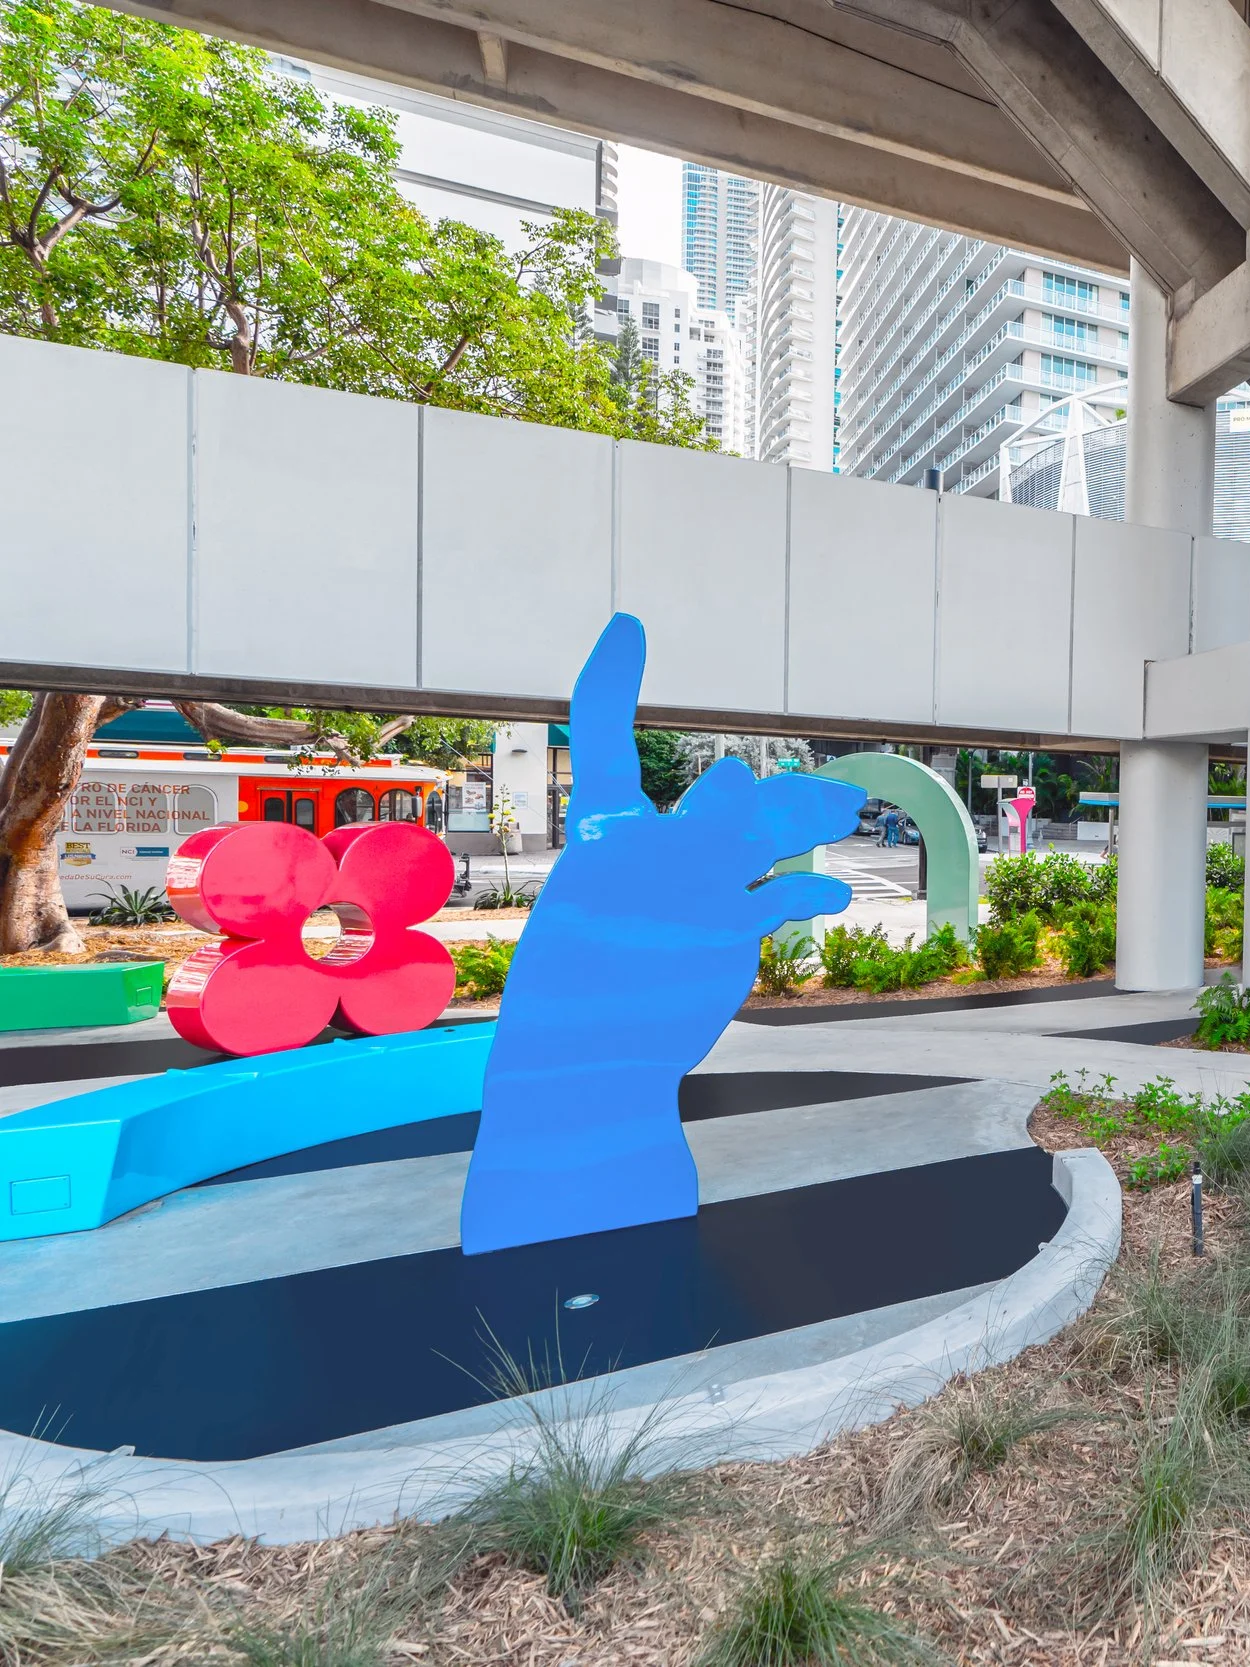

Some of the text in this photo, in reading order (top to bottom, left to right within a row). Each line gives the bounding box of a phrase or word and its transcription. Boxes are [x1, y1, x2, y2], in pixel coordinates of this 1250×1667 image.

[107, 783, 127, 793] DE
[131, 781, 190, 795] CÁNCER
[95, 796, 113, 806] EL
[117, 796, 143, 807] NCI
[148, 796, 158, 807] Y
[71, 808, 211, 821] A NIVEL NACIONAL
[74, 822, 93, 832] LA
[97, 822, 162, 833] FLORIDA
